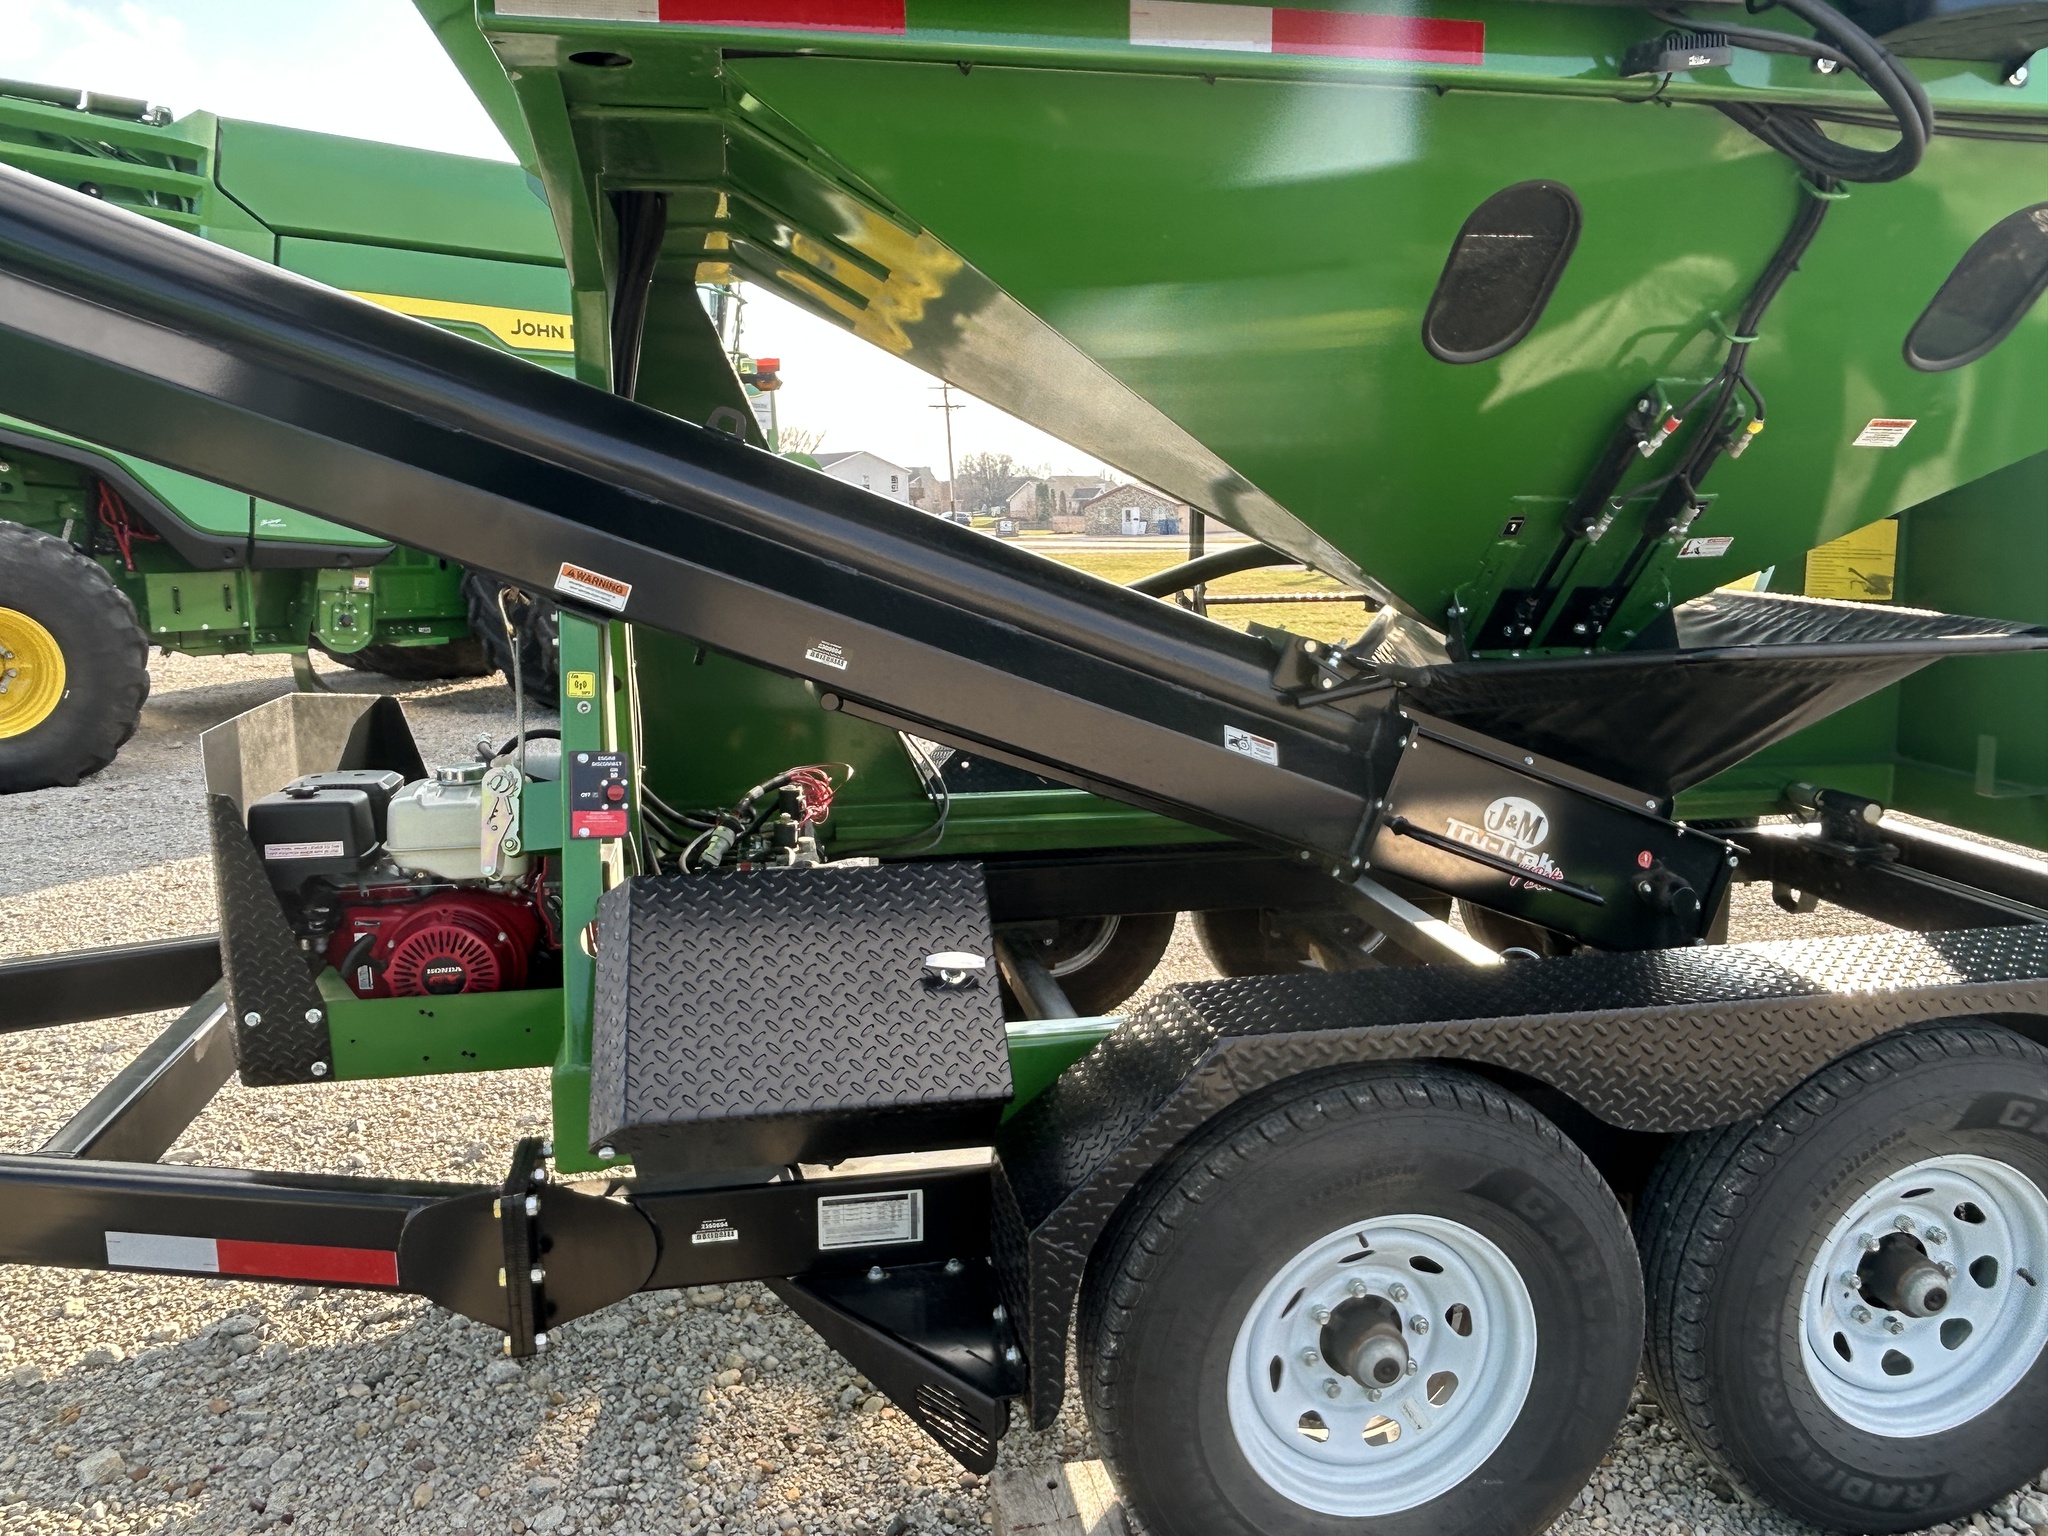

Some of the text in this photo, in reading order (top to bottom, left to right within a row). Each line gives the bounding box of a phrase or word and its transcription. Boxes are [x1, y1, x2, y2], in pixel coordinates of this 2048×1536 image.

[511, 319, 564, 339] JOHN
[577, 569, 623, 594] WARNING
[1487, 802, 1545, 846] J&M
[426, 966, 463, 975] HONDA
